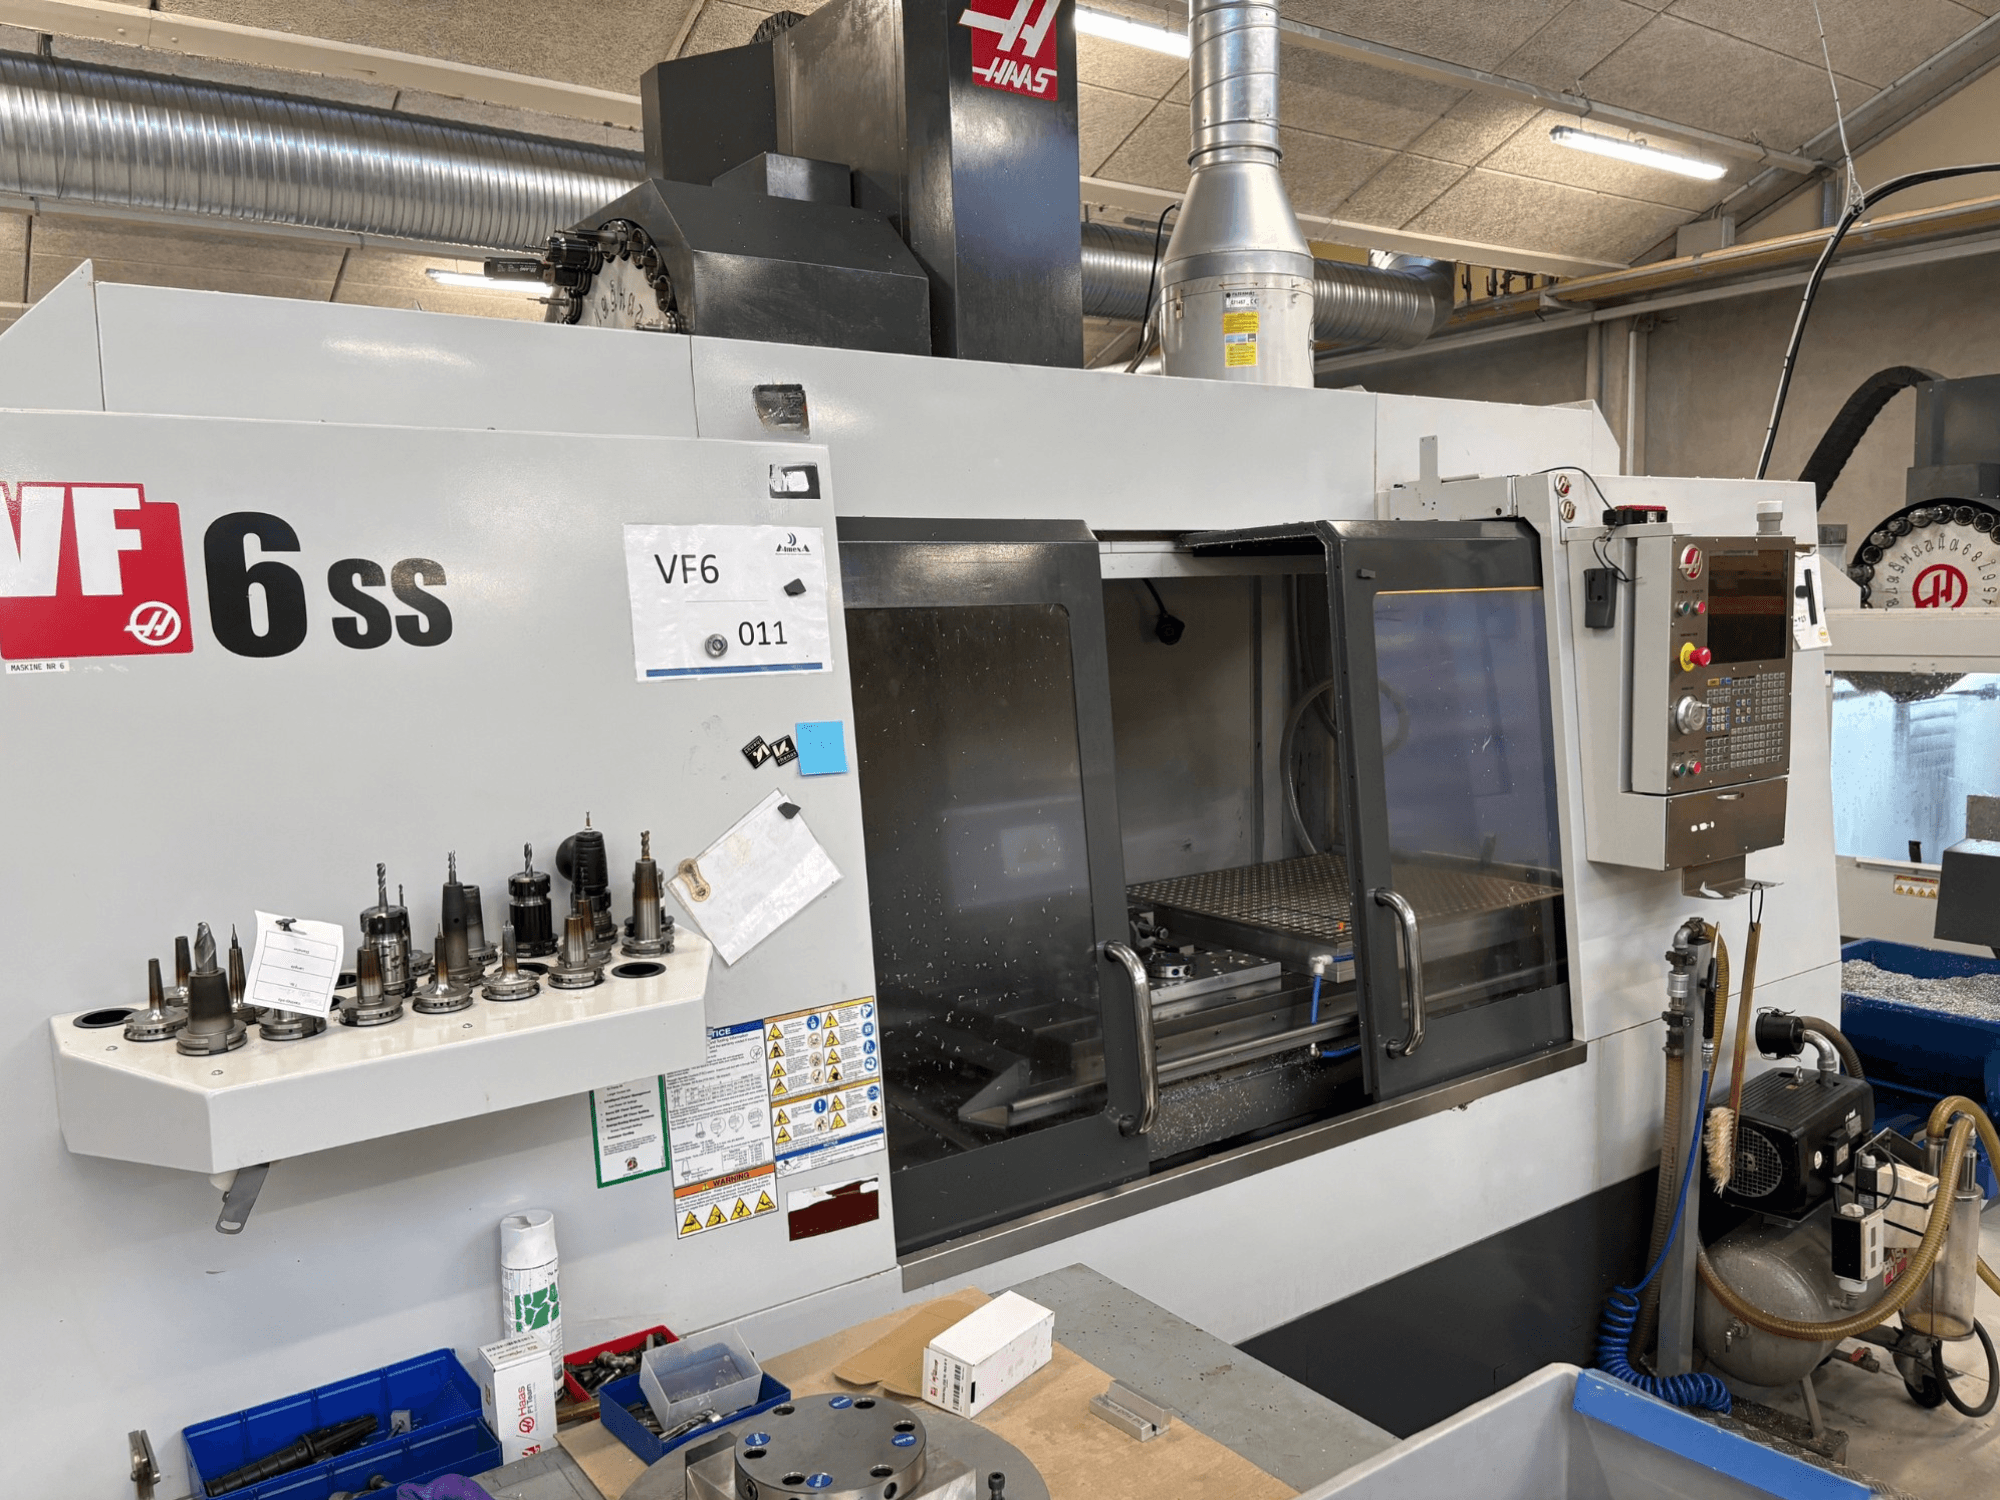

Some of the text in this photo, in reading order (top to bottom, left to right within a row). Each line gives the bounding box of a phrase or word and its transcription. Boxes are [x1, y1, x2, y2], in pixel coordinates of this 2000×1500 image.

[972, 57, 1057, 93] HAAS
[0, 486, 142, 597] VF
[204, 511, 307, 658] 6
[654, 554, 720, 584] VF6
[738, 620, 787, 646] 011
[11, 663, 42, 671] MASKINE
[711, 1028, 731, 1038] TICE
[713, 1172, 750, 1187] WARNING
[518, 1385, 526, 1417] Haas
[527, 1405, 534, 1414] F1
